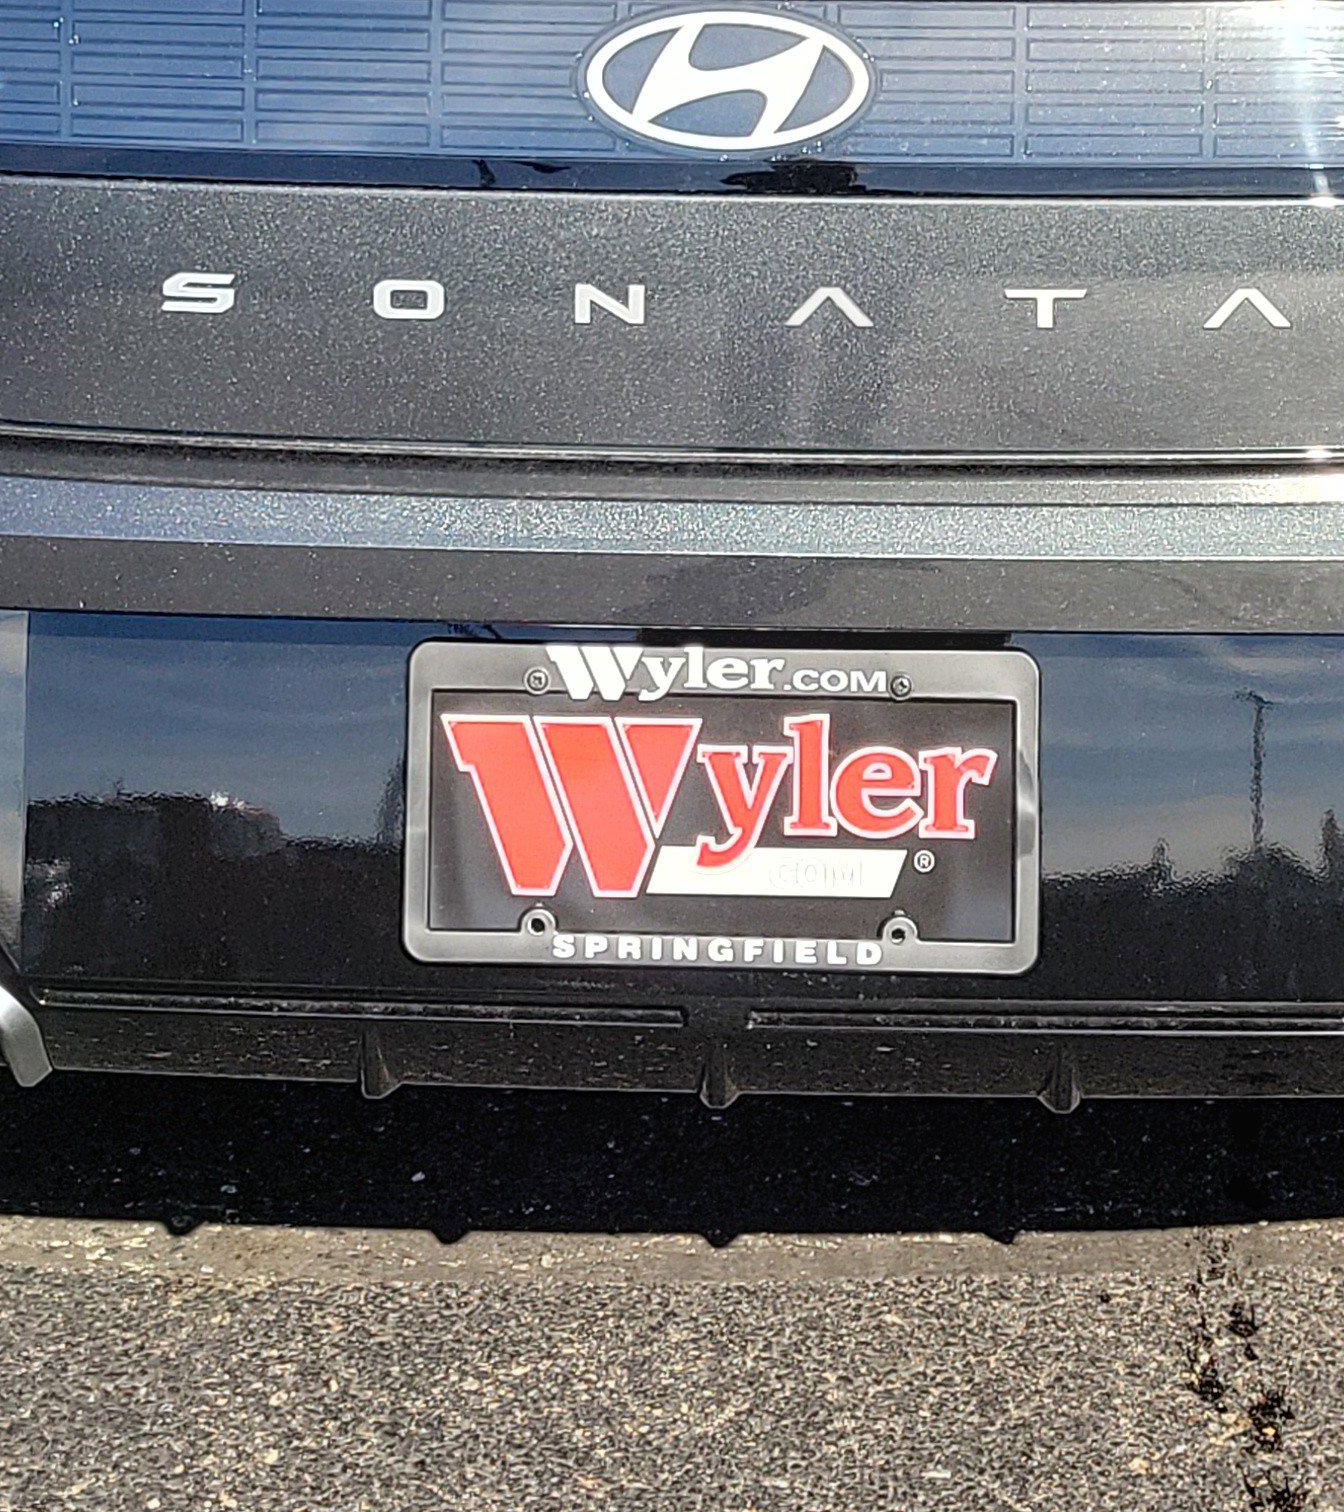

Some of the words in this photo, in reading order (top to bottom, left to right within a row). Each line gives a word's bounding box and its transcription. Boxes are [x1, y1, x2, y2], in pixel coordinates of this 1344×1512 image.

[161, 271, 1292, 329] SONATA
[441, 713, 997, 898] Wyler
[552, 934, 882, 966] SPRINGFIELD
